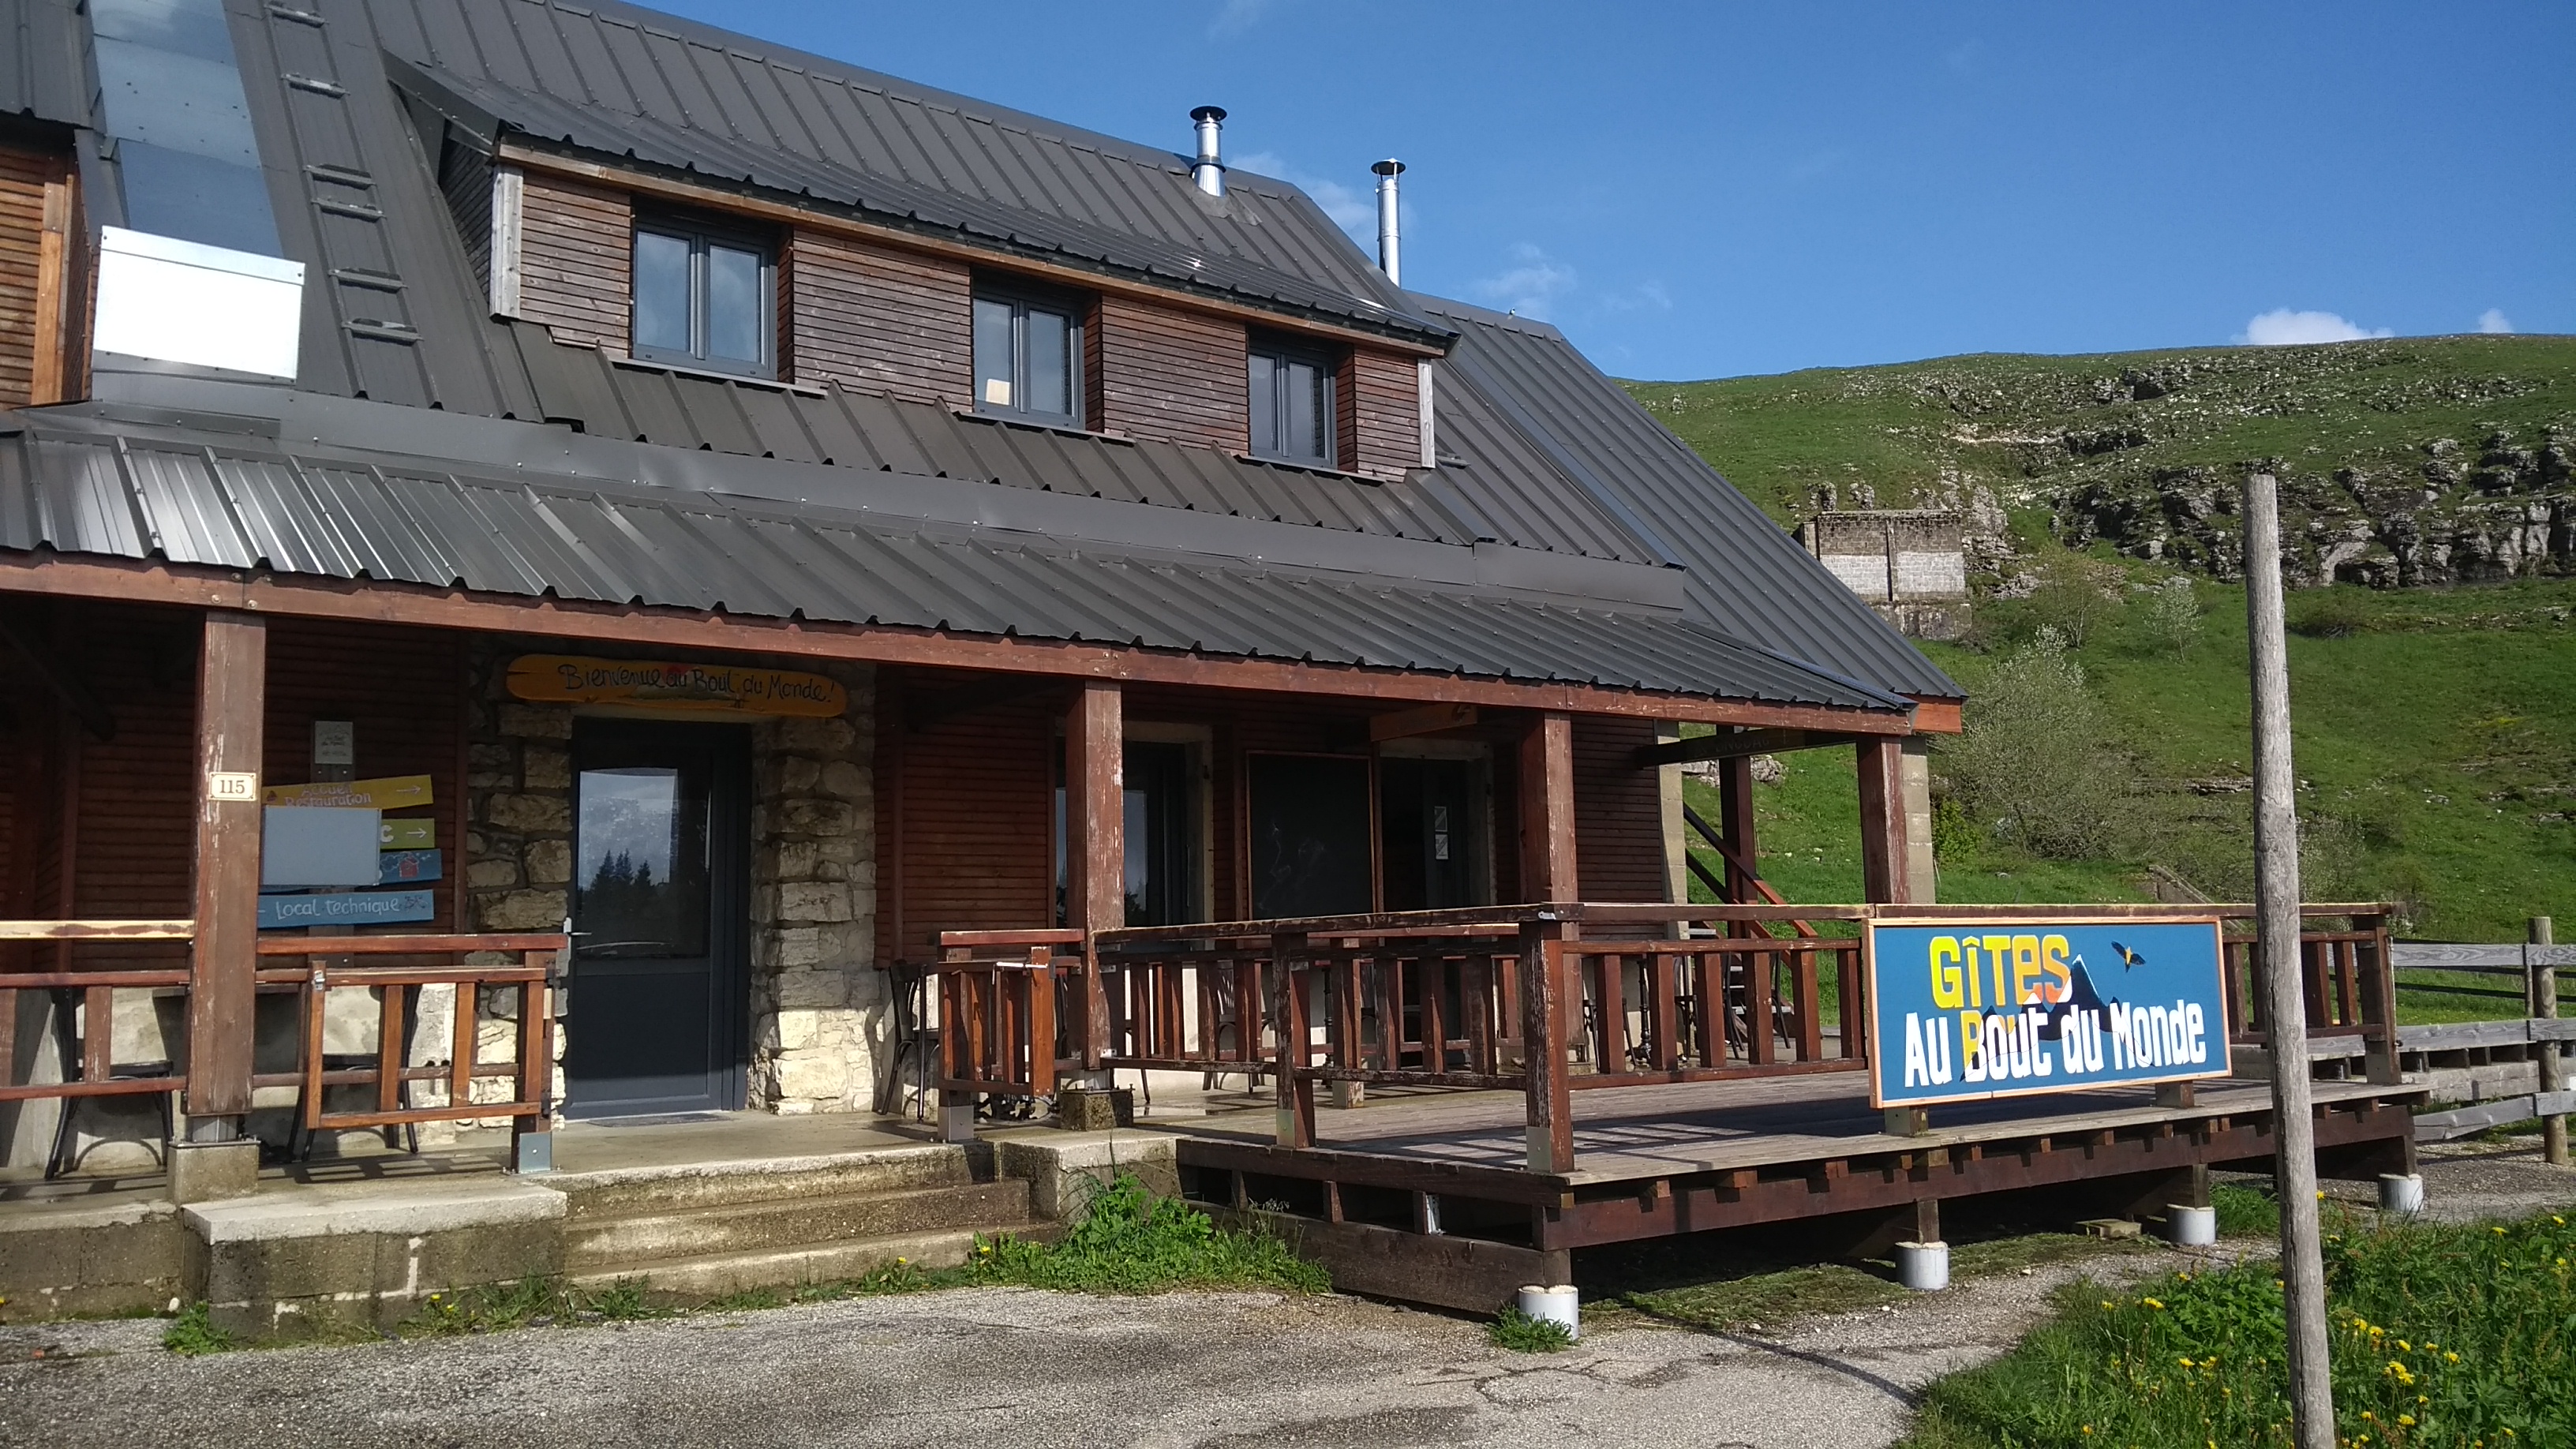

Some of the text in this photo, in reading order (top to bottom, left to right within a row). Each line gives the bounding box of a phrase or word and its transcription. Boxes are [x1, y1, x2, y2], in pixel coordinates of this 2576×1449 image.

[558, 664, 835, 702] Bienvenue au Bout du Monde!
[219, 779, 245, 794] 115
[301, 783, 352, 796] Accueil
[284, 792, 372, 807] Restauration
[275, 897, 401, 920] Local technique
[1904, 999, 2207, 1088] Au Bout du Monde
